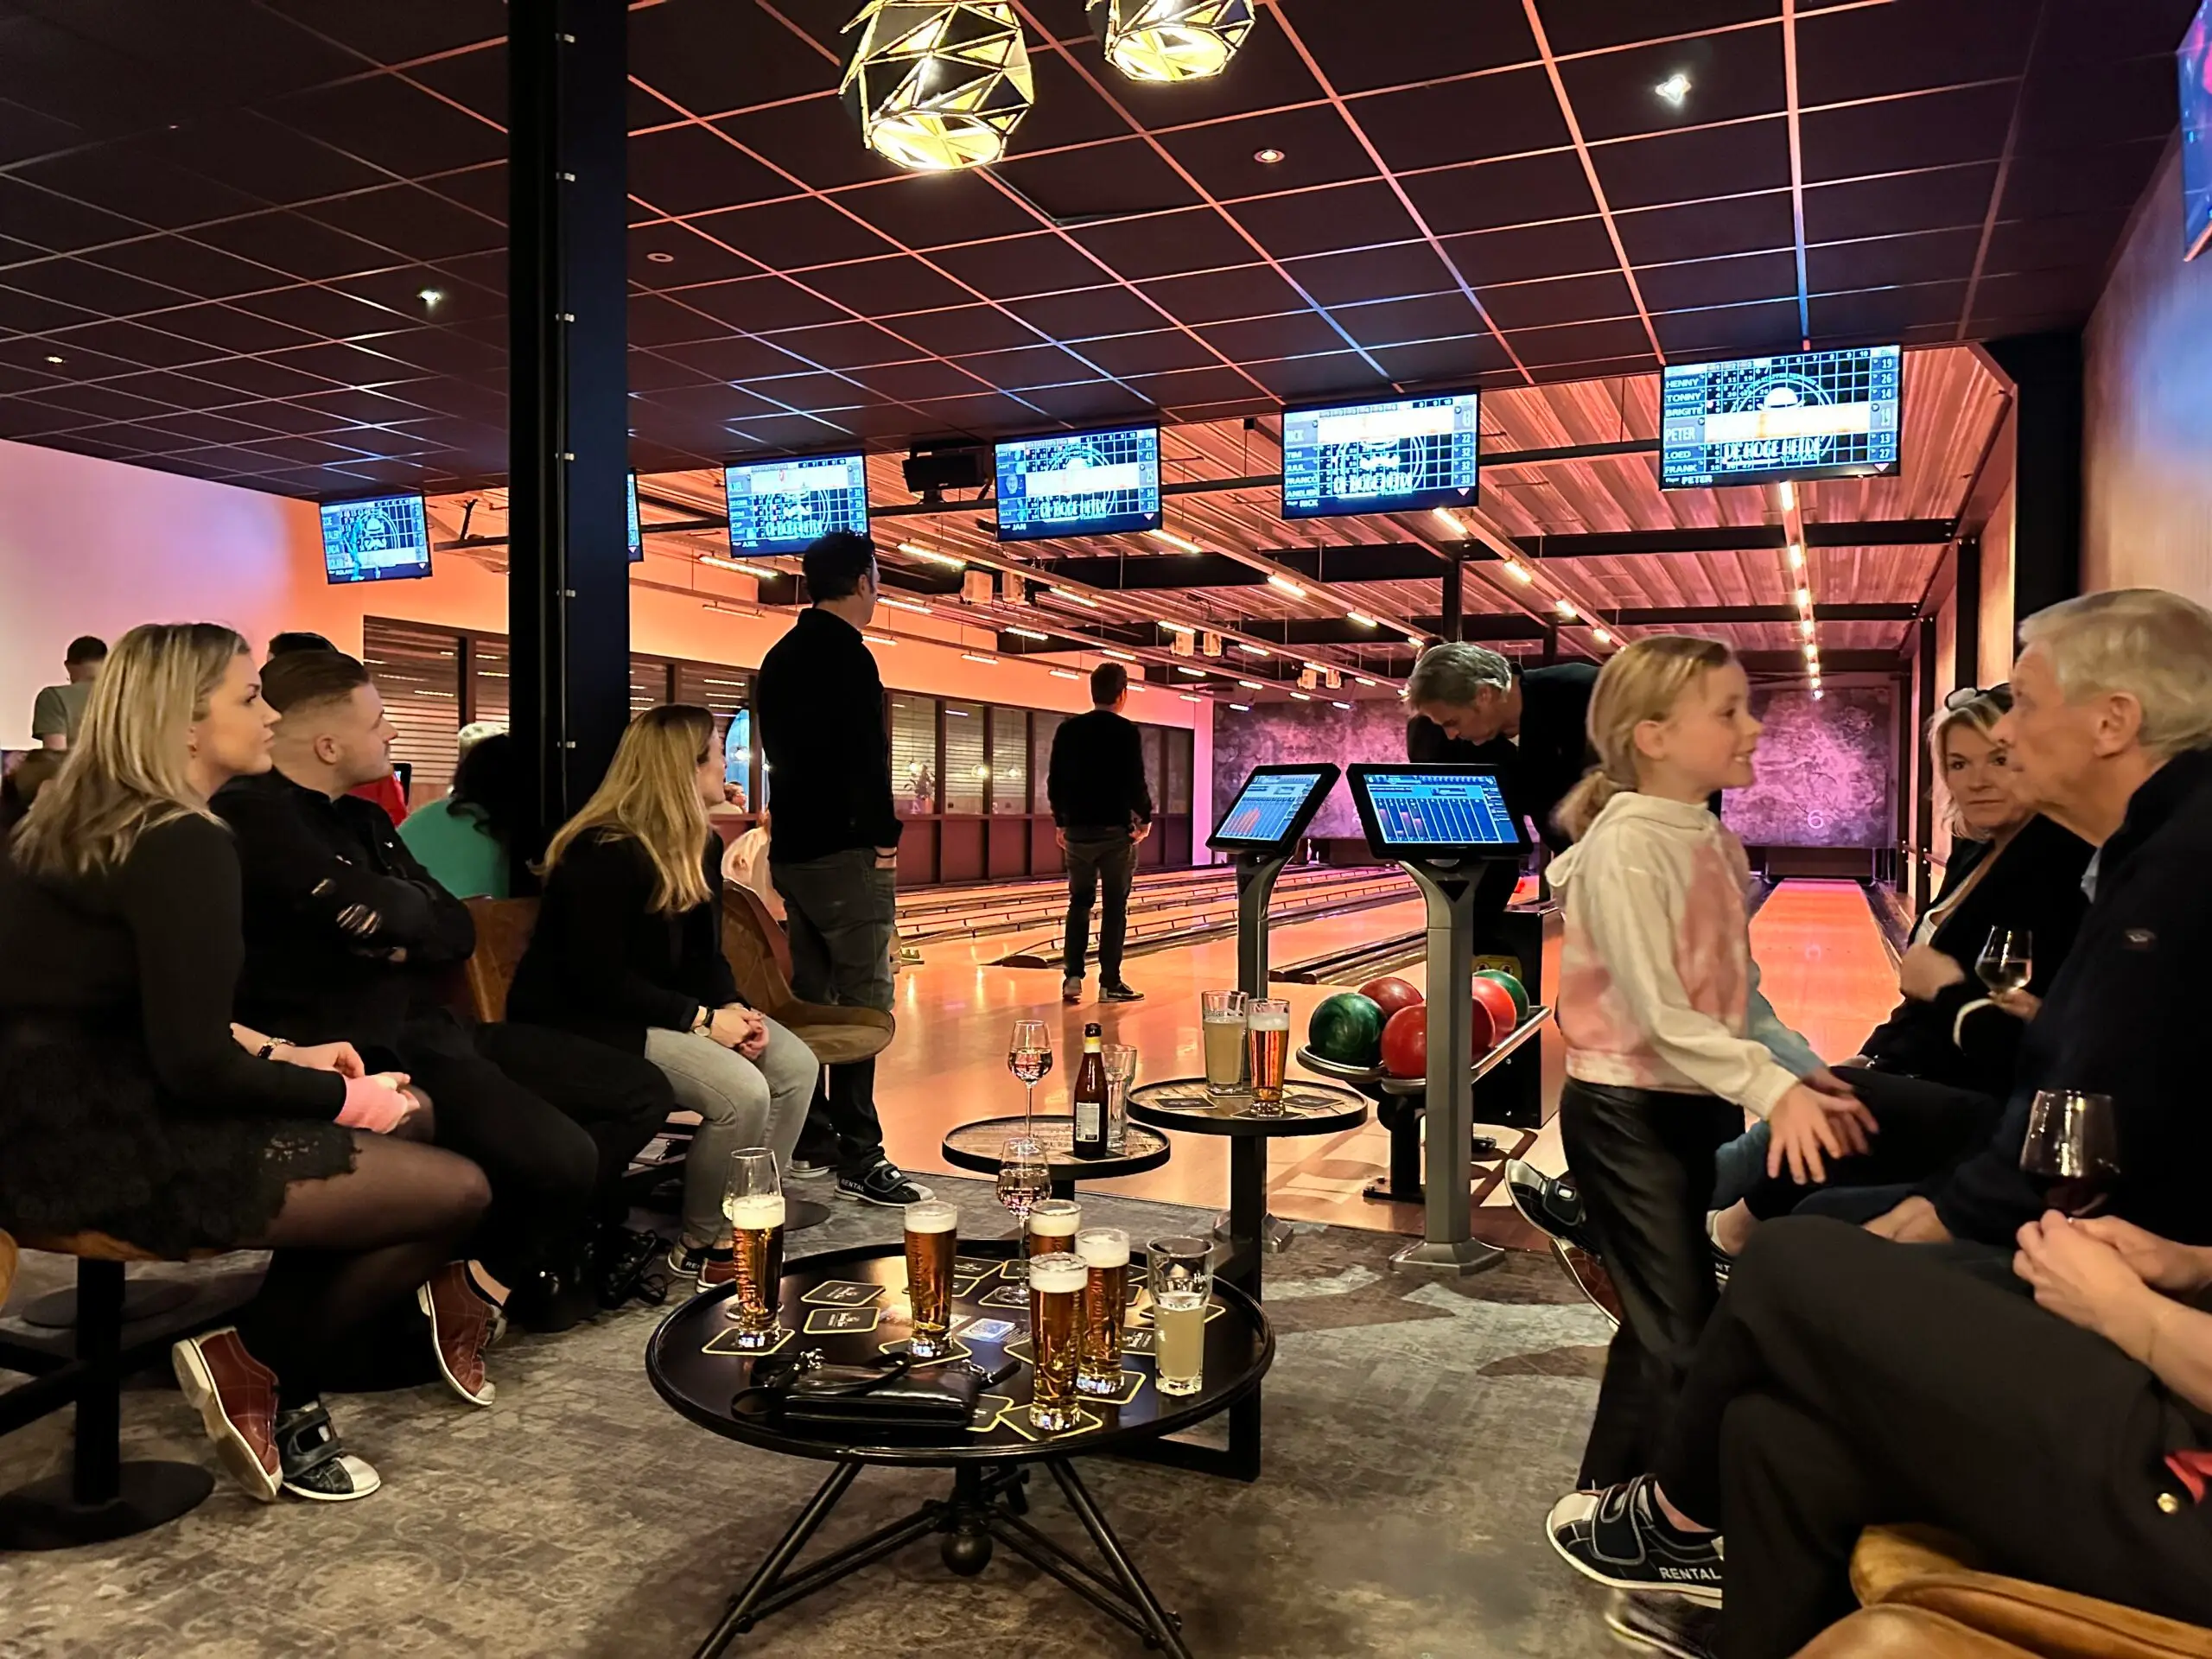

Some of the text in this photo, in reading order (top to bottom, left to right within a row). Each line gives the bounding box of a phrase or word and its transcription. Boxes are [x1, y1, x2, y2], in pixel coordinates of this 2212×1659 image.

[1882, 359, 1892, 368] 19
[1666, 378, 1699, 388] HENNY
[1881, 373, 1892, 384] 26
[1666, 392, 1701, 403] TONNY
[1881, 388, 1891, 398] 14
[1462, 434, 1471, 443] 22
[1666, 427, 1695, 442] PETER
[1879, 434, 1891, 443] 13
[1665, 450, 1692, 459] LOED
[1879, 448, 1890, 458] 27
[1665, 464, 1698, 474] FRANK
[1681, 475, 1713, 485] PETER
[1808, 810, 1823, 829] 6
[1658, 1567, 1722, 1580] RENTAL
